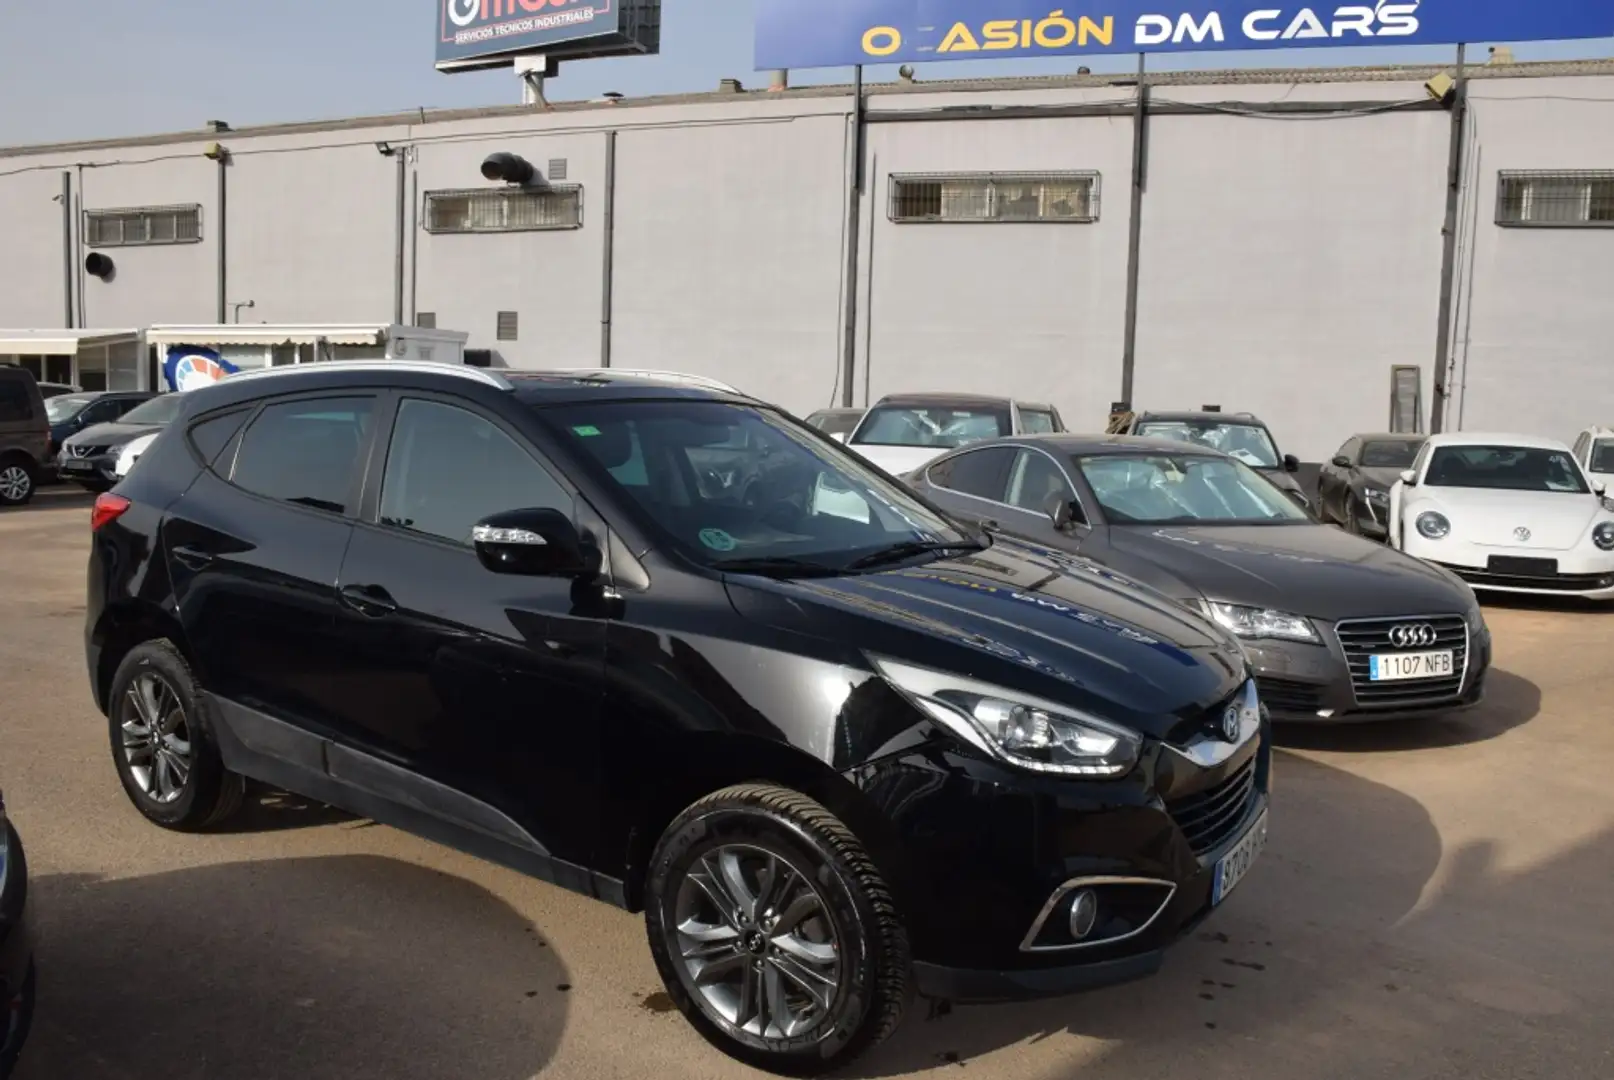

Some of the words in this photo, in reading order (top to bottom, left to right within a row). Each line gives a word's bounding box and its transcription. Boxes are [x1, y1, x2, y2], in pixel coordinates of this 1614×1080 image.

[455, 27, 493, 43] SERVICIOS
[534, 9, 594, 29] INDUSTRIALES
[861, 9, 1114, 56] OASIÓN
[1134, 11, 1225, 45] DM
[1384, 656, 1421, 675] 1107
[1425, 654, 1450, 673] NFB
